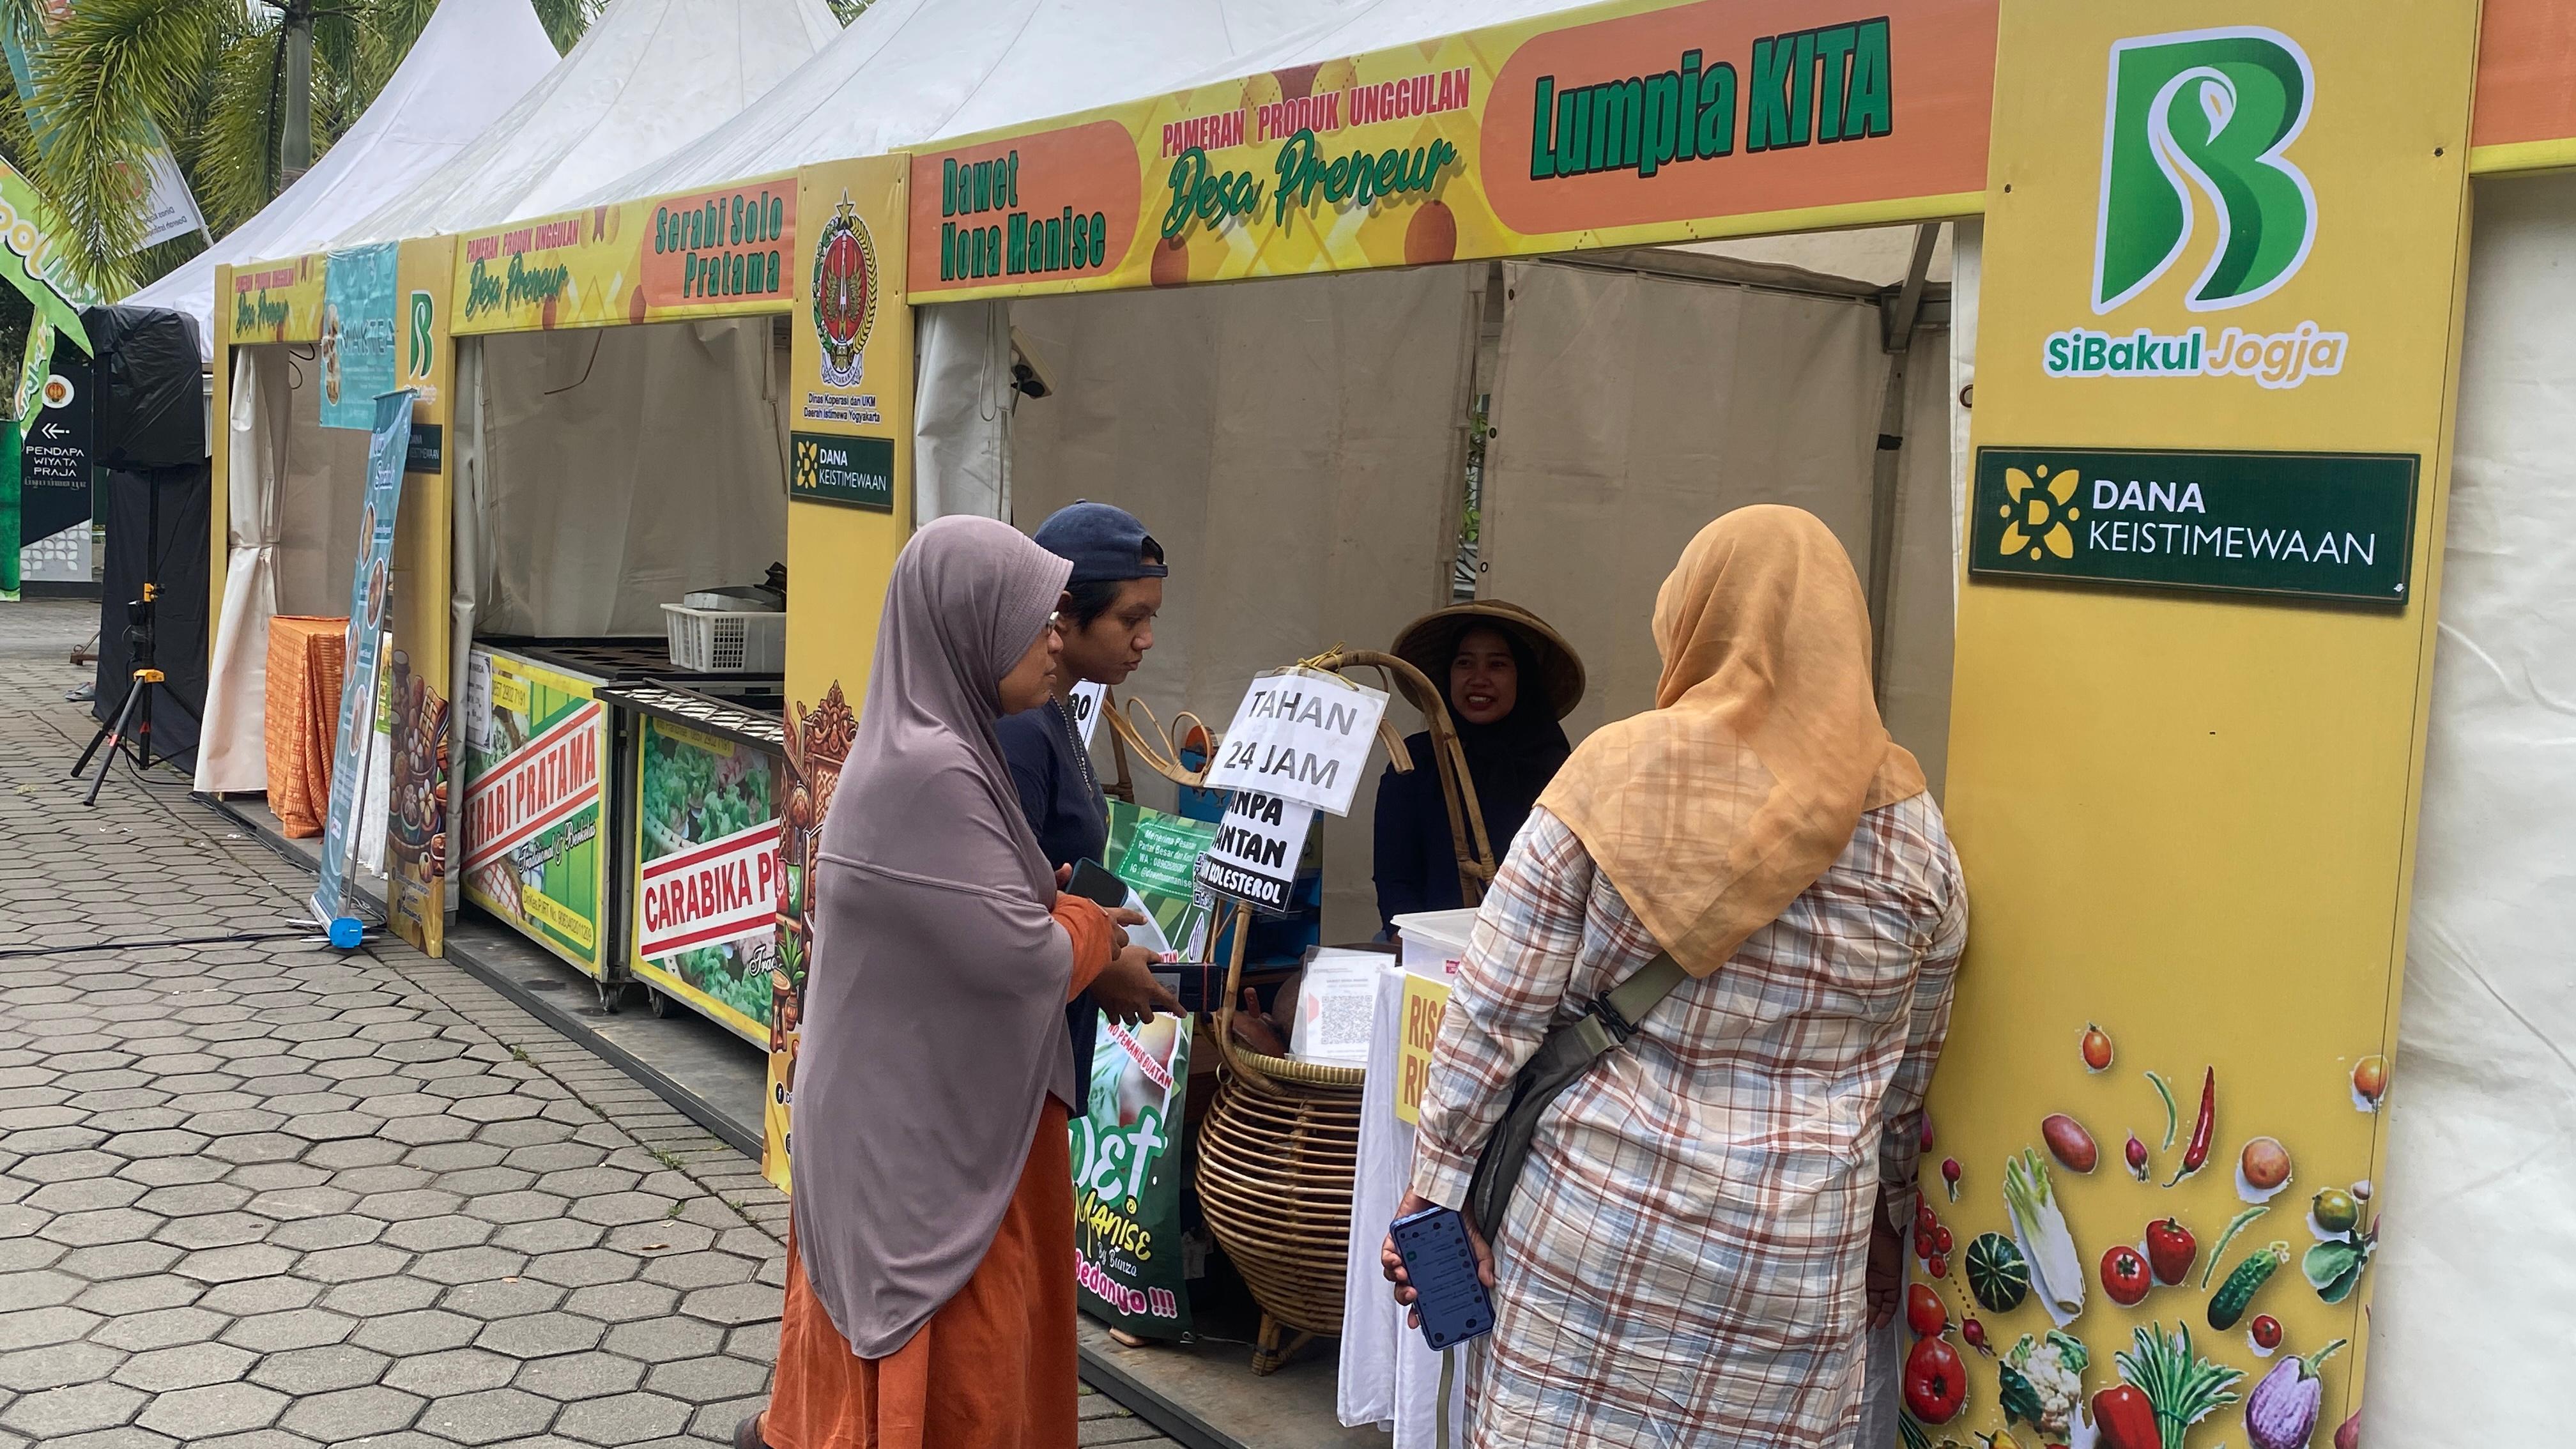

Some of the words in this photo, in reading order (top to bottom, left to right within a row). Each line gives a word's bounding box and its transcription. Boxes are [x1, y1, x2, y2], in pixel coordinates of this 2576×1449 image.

[1162, 109, 1245, 159] PAMERAN
[1257, 91, 1340, 143] PRODUK
[1349, 67, 1471, 126] UNGGULAN
[1530, 49, 1737, 180] Lumpia
[1746, 16, 1892, 153] KITA
[942, 150, 1019, 217] Dawet
[1162, 146, 1264, 239] Desa
[1275, 128, 1457, 229] Preneur
[655, 196, 726, 254] Serabi
[731, 191, 783, 245] Solo
[940, 220, 1000, 282] Nona
[1006, 206, 1106, 275] Manise
[683, 250, 781, 298] Pratama
[2048, 334, 2200, 372] SiBakul
[2209, 327, 2341, 381] Jogja
[862, 395, 876, 407] UKM
[26, 446, 84, 457] PENDAPA
[34, 457, 77, 467] WIYATA
[34, 467, 77, 477] PRAJA
[820, 448, 848, 466] DANA
[819, 469, 886, 491] KEISTIMEWAAN
[2092, 480, 2205, 514] DANA
[2089, 521, 2375, 566] KEISTIMEWAAN
[1248, 691, 1358, 735] TAHAN
[516, 724, 595, 824] PRATAMA
[1223, 740, 1254, 770] 24
[1259, 744, 1340, 790] JAM
[1130, 863, 1138, 873] IG
[1139, 853, 1149, 863] WA
[1154, 845, 1174, 857] Besar
[1213, 823, 1287, 868] ANTAN
[645, 859, 753, 933] CARABIKA
[1208, 861, 1281, 903] KOLESTEROL
[1117, 1031, 1146, 1064] PEMANIS
[1141, 1055, 1173, 1089] BUATAN
